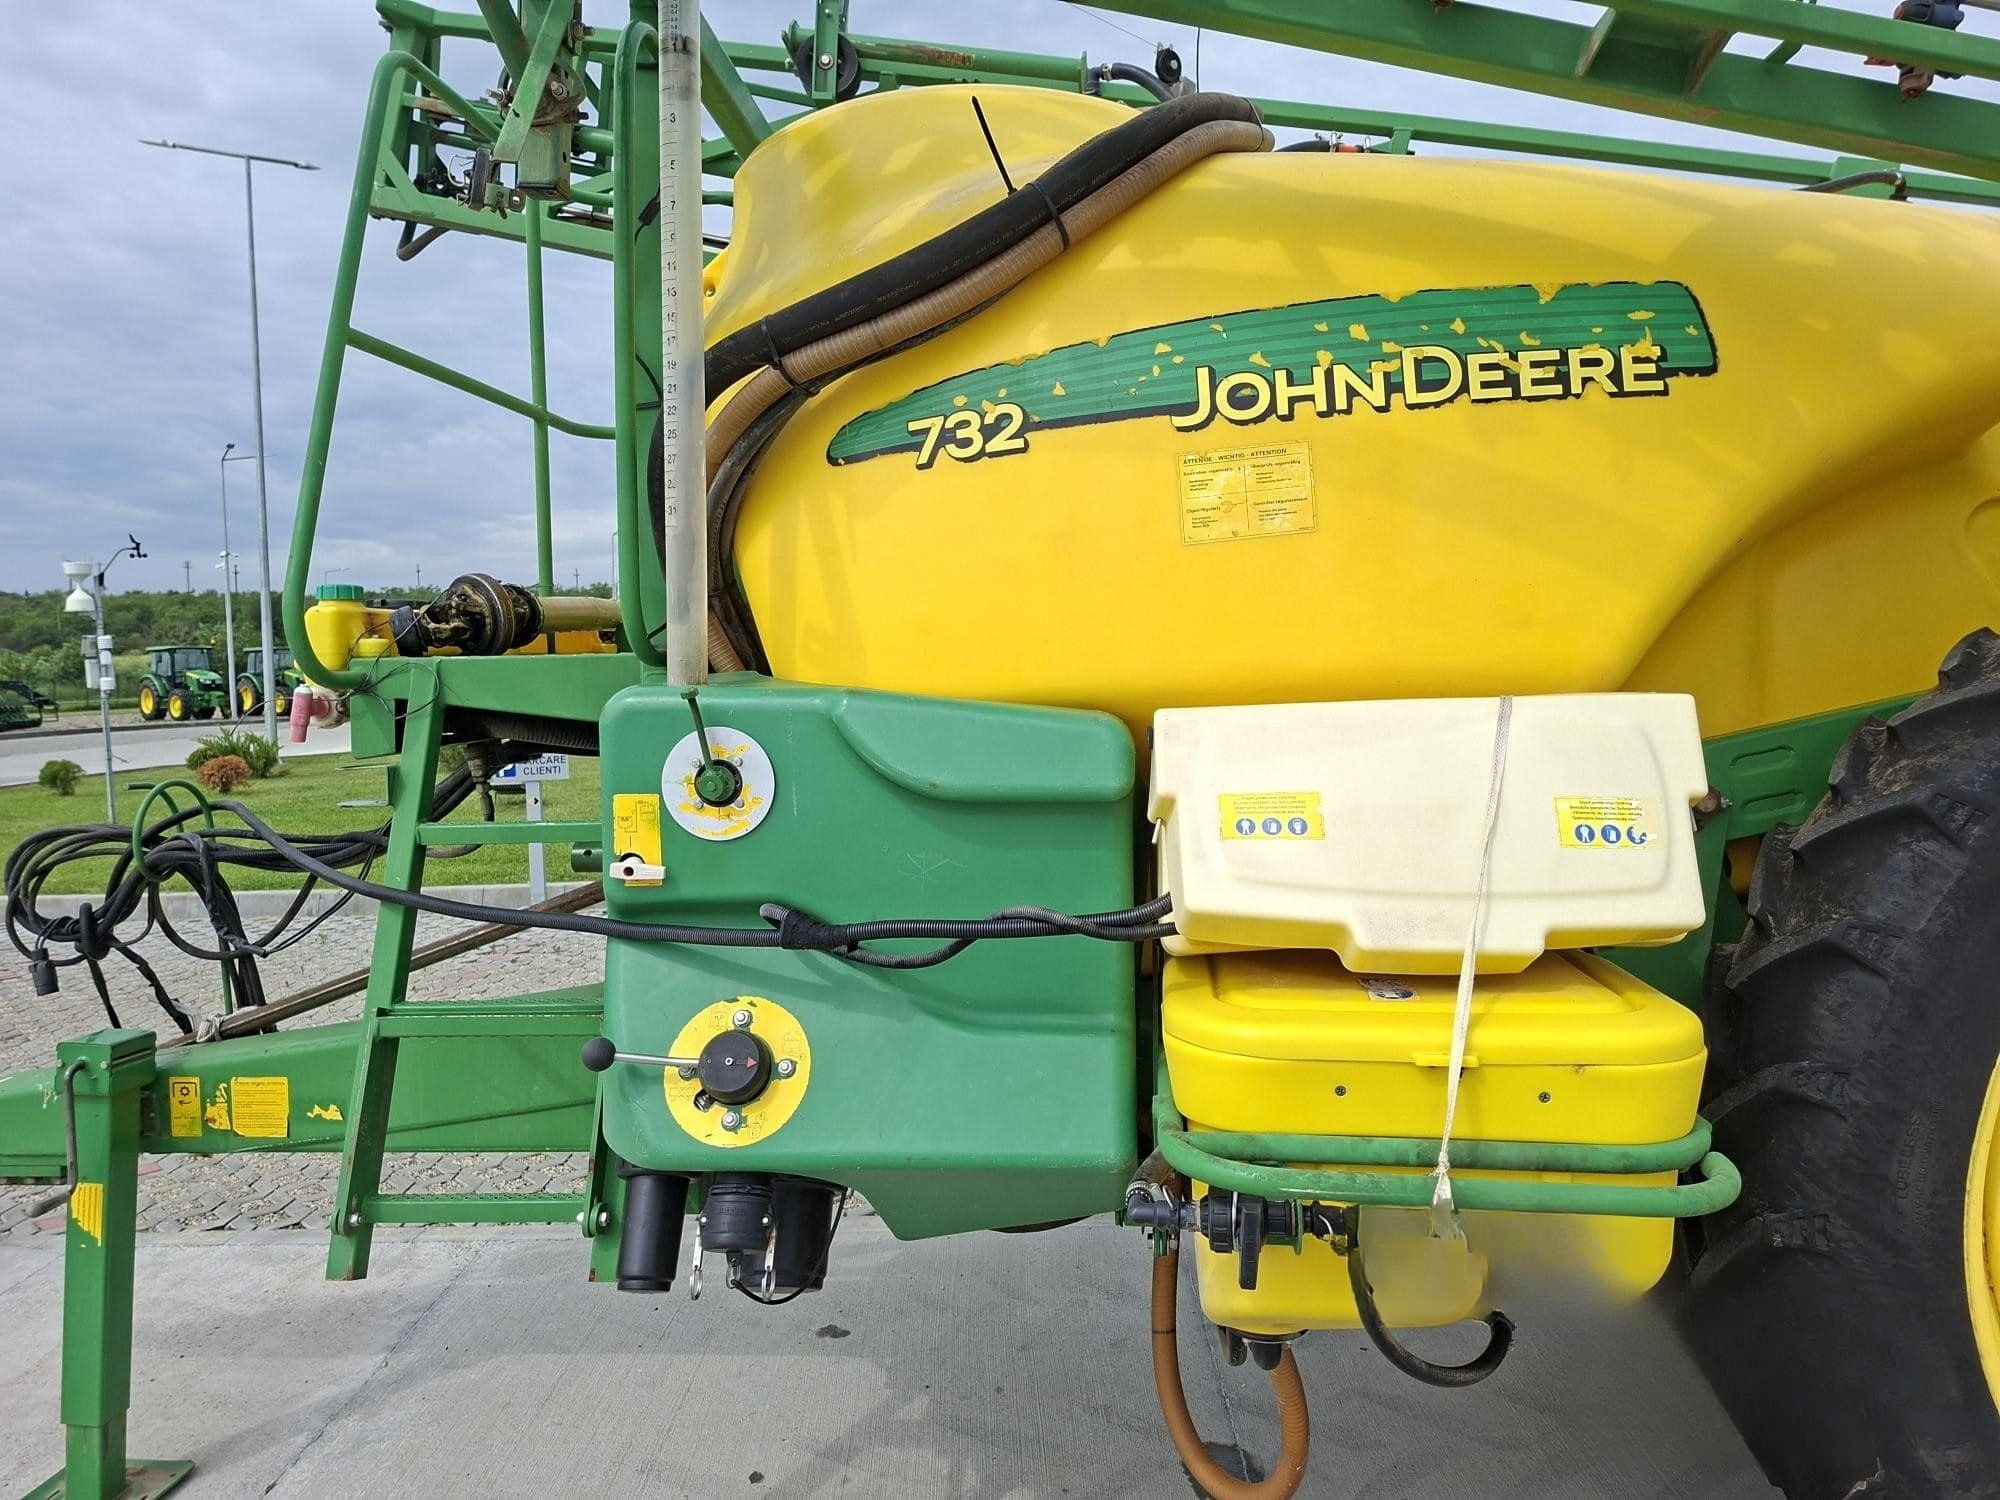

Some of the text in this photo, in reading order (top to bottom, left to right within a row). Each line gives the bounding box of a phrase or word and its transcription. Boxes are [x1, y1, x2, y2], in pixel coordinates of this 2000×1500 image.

[670, 112, 676, 123] 3
[670, 160, 676, 170] 5
[670, 201, 676, 210] 7
[667, 287, 677, 297] 13
[667, 312, 676, 322] 15
[667, 336, 676, 347] 17
[667, 360, 677, 370] 19
[667, 384, 677, 394] 21
[1170, 345, 1666, 428] JOHN DEERE
[667, 405, 677, 415] 23
[667, 429, 677, 439] 25
[907, 403, 1025, 466] 732
[667, 454, 677, 464] 27
[1218, 452, 1245, 461] WICHTIG
[1250, 448, 1287, 457] ATTENTION
[667, 480, 676, 488] 2
[667, 506, 677, 516] 31
[526, 756, 566, 765] ARCARE
[524, 766, 560, 775] CLIENTI
